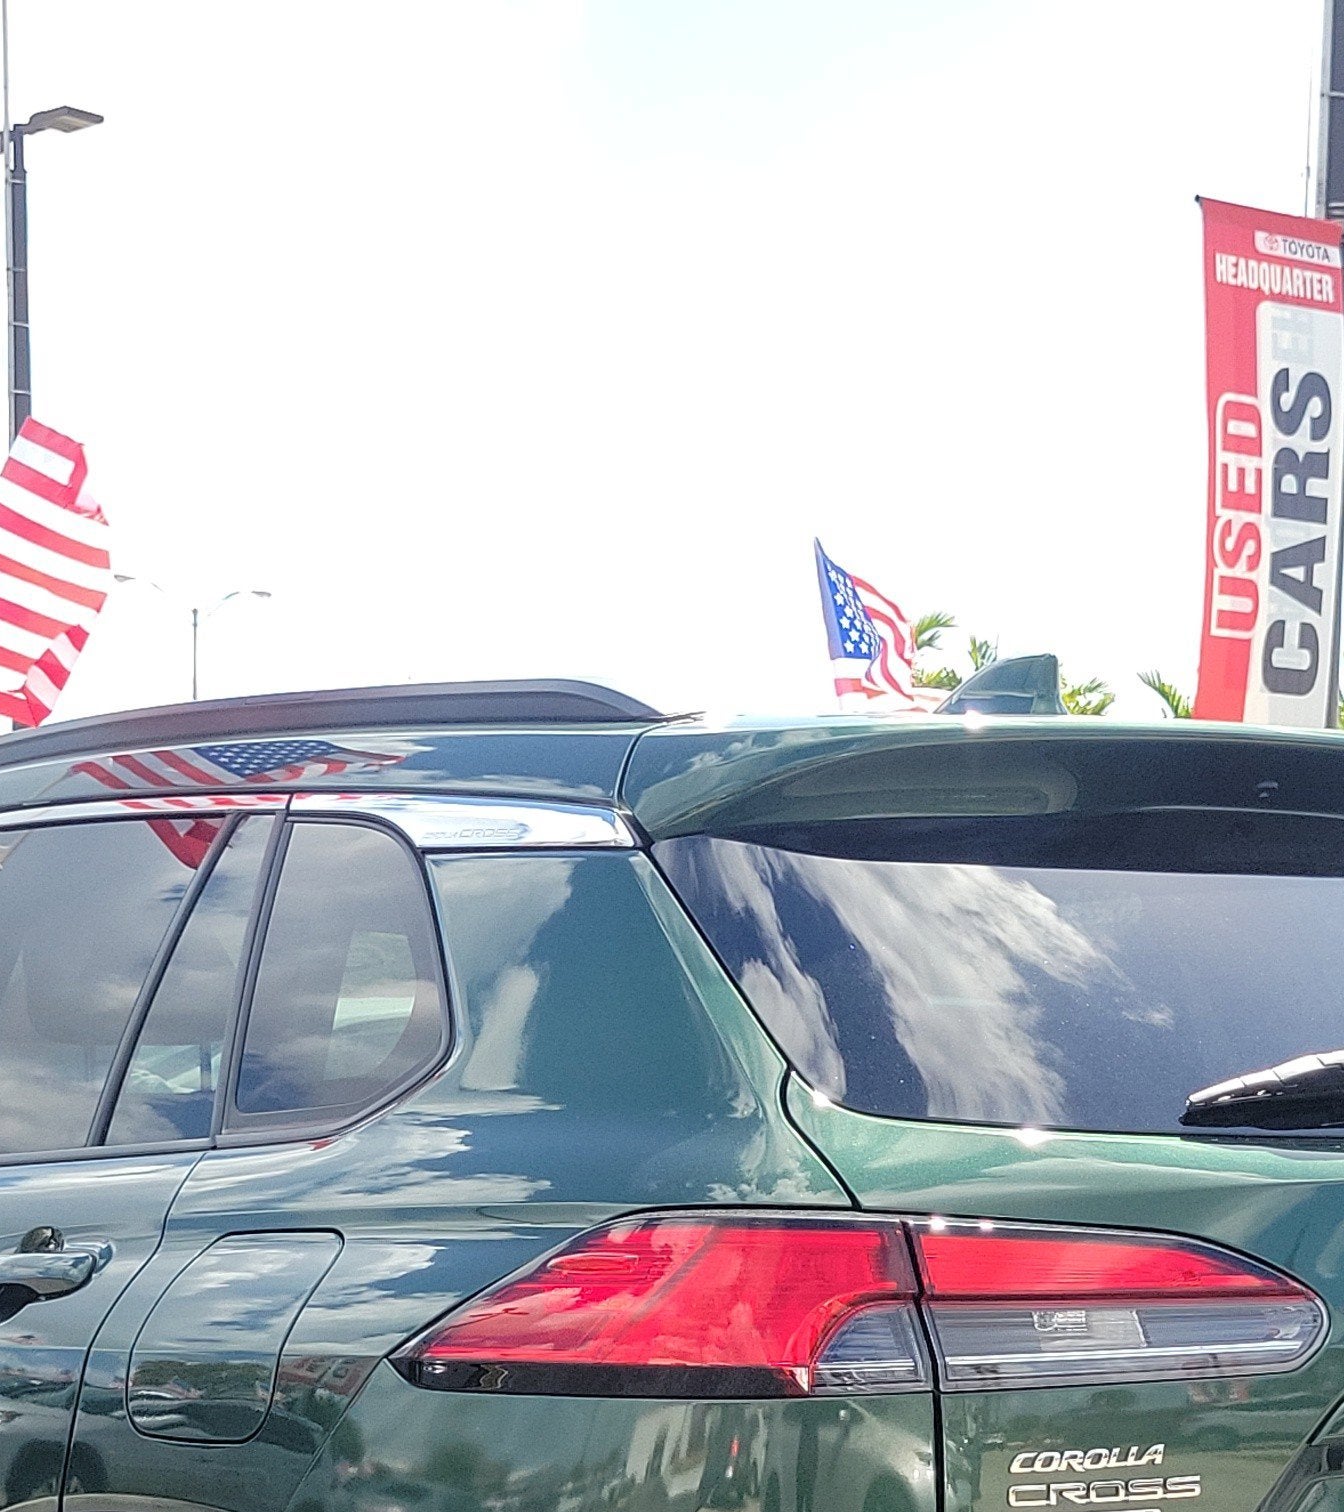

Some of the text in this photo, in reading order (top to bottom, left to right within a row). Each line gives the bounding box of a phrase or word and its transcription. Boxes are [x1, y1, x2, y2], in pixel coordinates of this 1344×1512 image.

[1281, 238, 1331, 262] TOYOTA
[1215, 252, 1334, 303] HEADQUARTER
[1212, 393, 1261, 638] USED
[1261, 367, 1332, 696] CARS
[1009, 1443, 1165, 1474] COROLLA
[1007, 1475, 1202, 1507] CROSS
